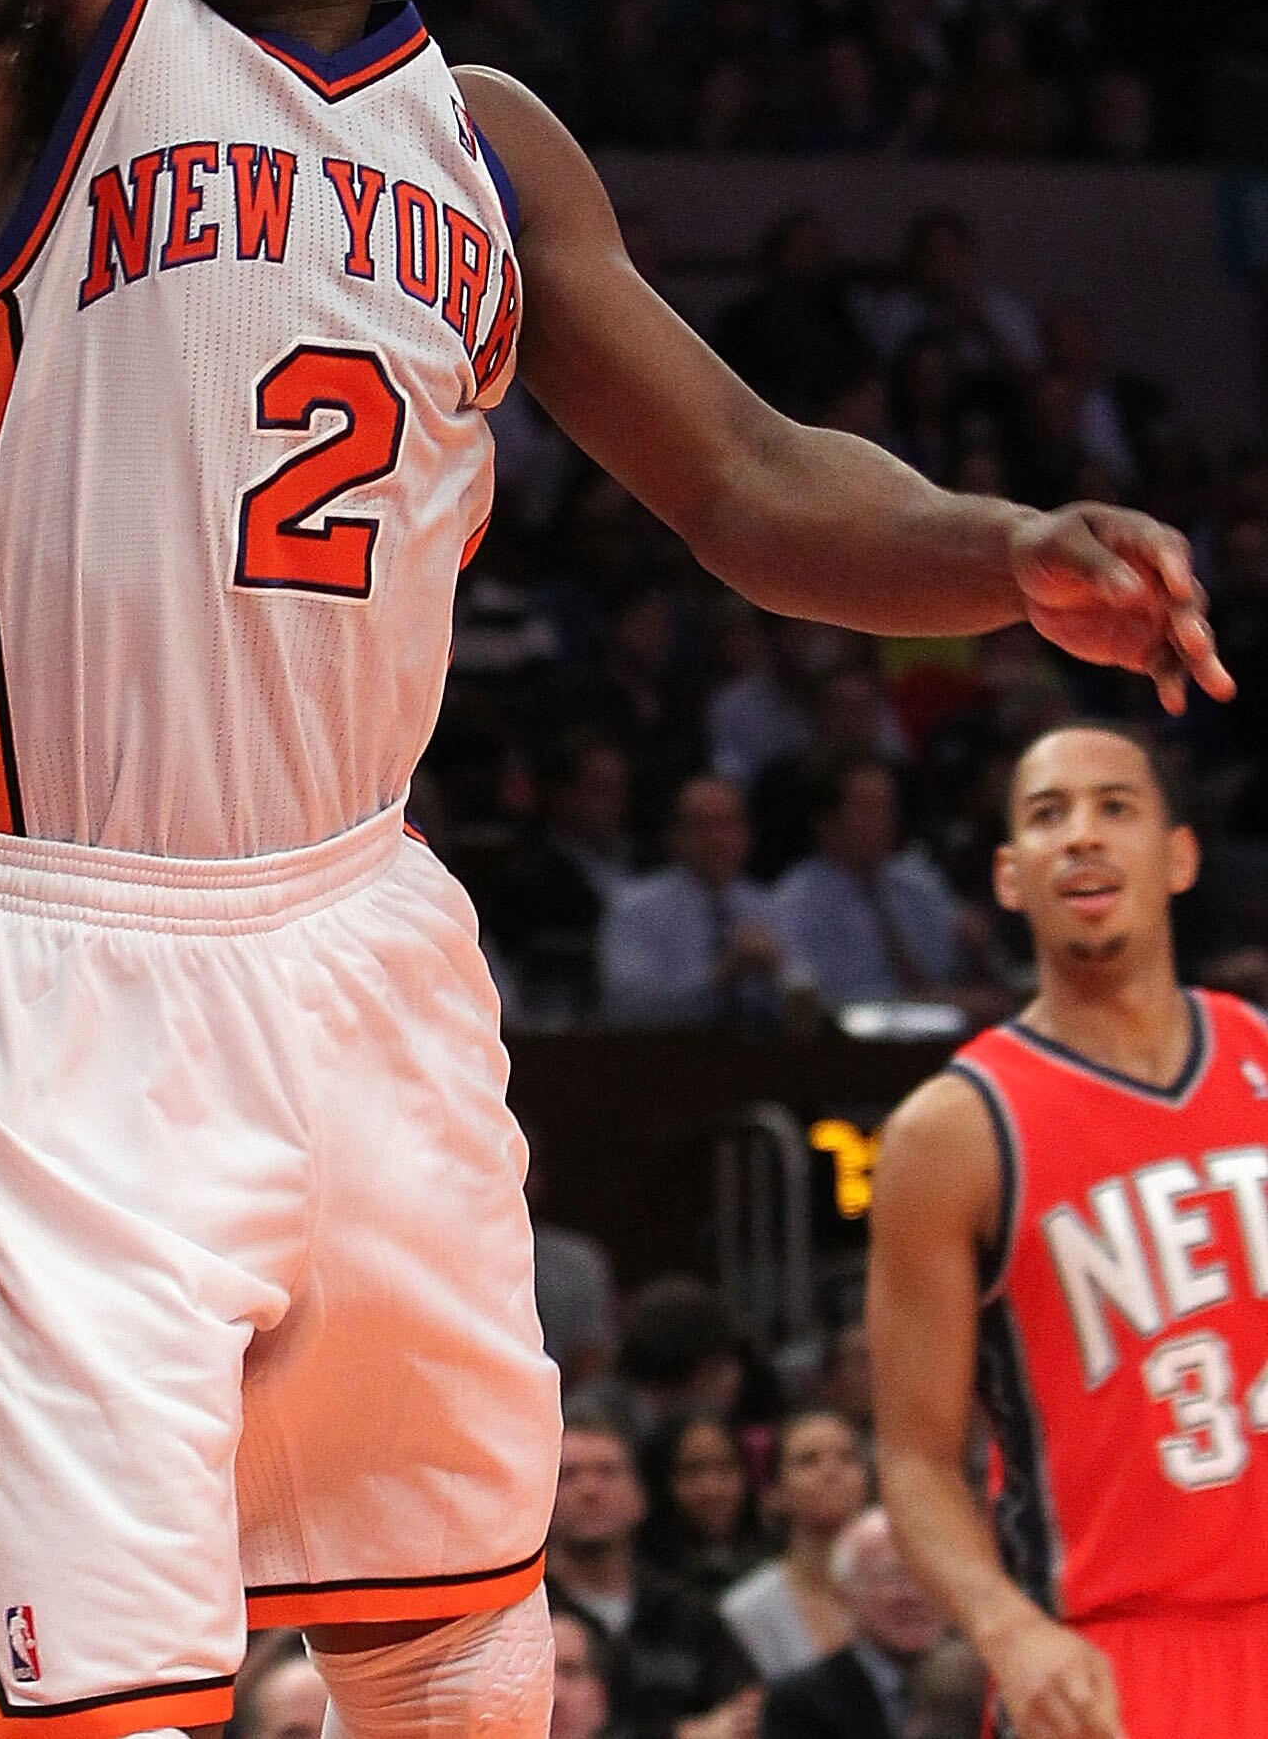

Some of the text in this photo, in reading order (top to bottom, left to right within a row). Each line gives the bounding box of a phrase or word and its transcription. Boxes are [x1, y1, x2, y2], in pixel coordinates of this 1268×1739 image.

[77, 140, 517, 399] NEW YORK
[231, 341, 407, 601] 2
